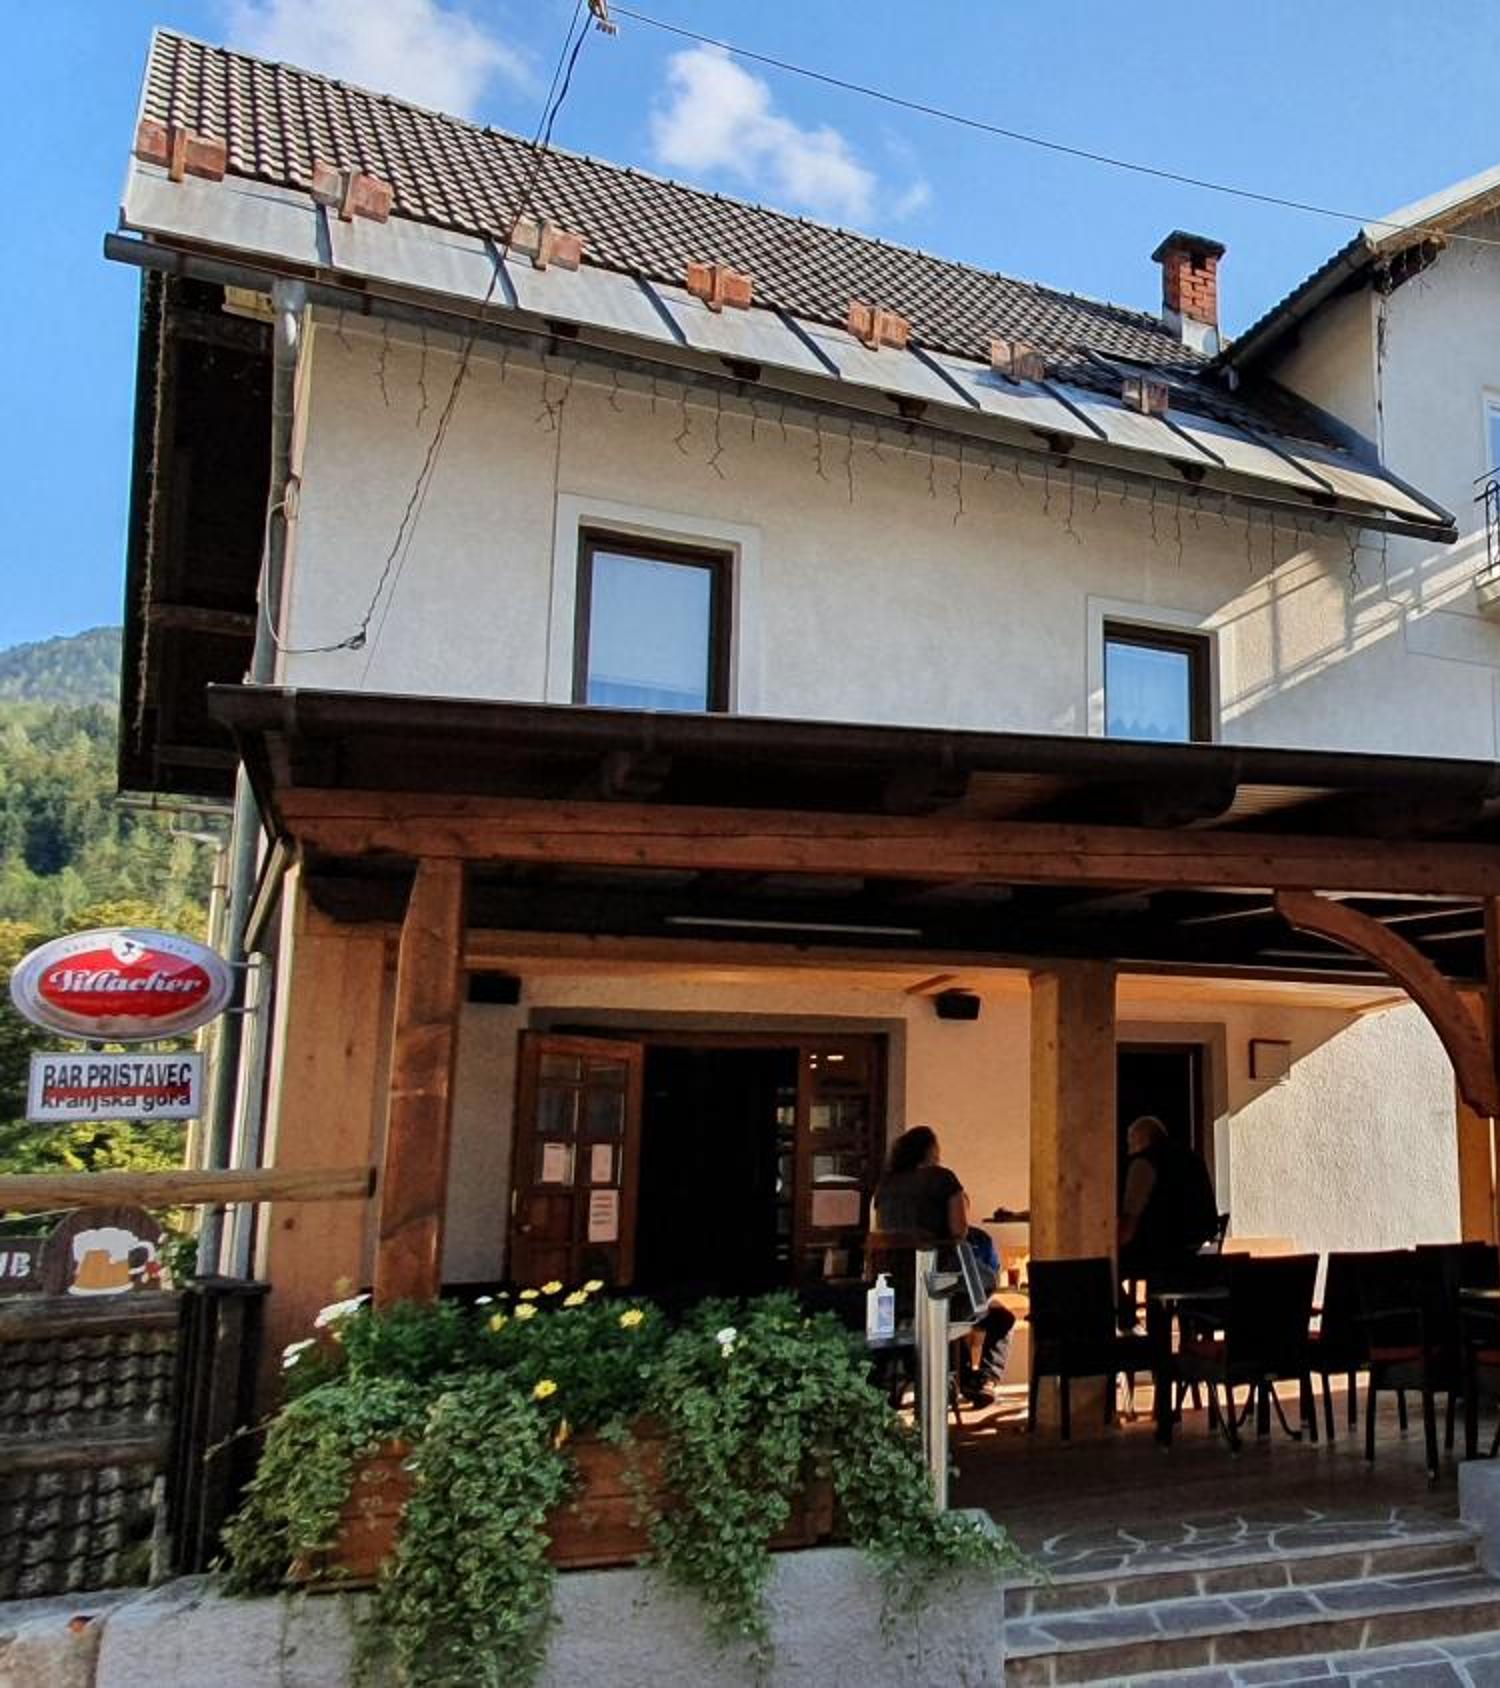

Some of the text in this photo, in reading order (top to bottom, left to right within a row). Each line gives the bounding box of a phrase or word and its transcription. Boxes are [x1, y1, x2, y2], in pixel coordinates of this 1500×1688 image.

[49, 968, 202, 993] Villacher
[43, 1063, 192, 1088] BAR PRISTAVEC
[142, 1093, 191, 1112] gora
